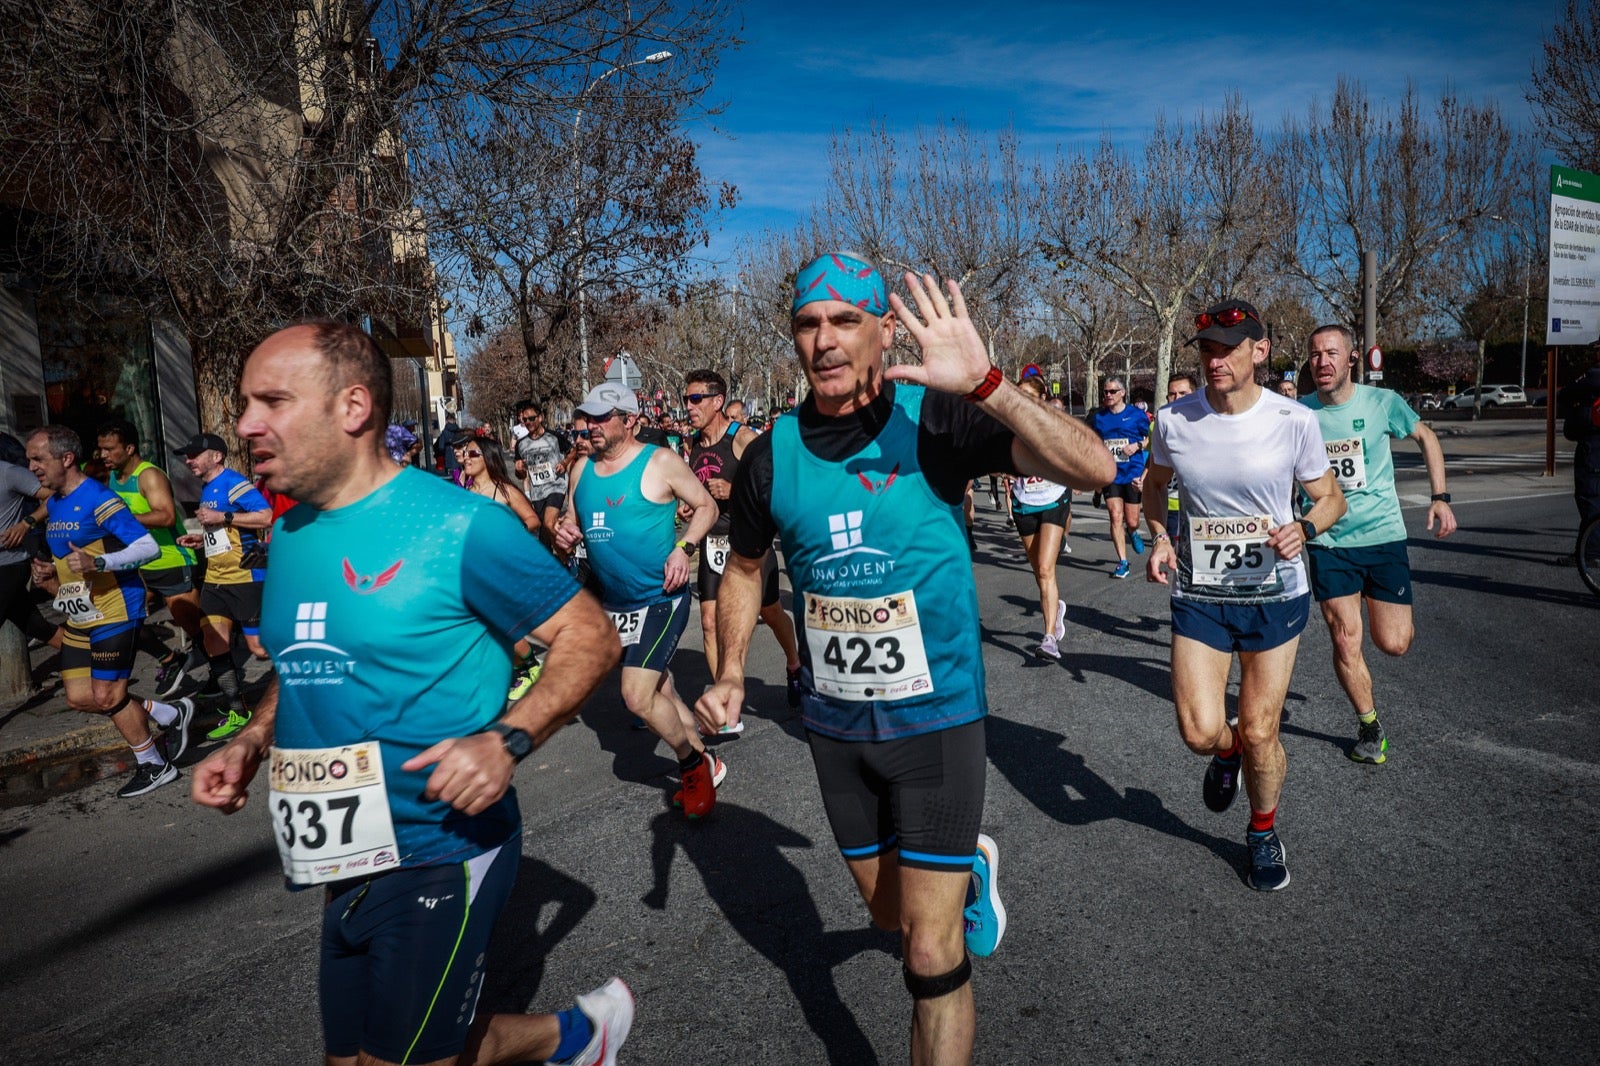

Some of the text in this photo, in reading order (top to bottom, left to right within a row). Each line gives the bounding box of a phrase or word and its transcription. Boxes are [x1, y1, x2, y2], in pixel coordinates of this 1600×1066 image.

[533, 470, 550, 480] 703
[1208, 522, 1257, 535] FONDO
[1204, 543, 1264, 570] 735
[812, 560, 896, 580] INNOVENT
[58, 598, 90, 616] 206
[821, 606, 890, 624] FONDO
[824, 636, 905, 674] 423
[278, 759, 348, 782] FONDO
[278, 794, 361, 849] 337
